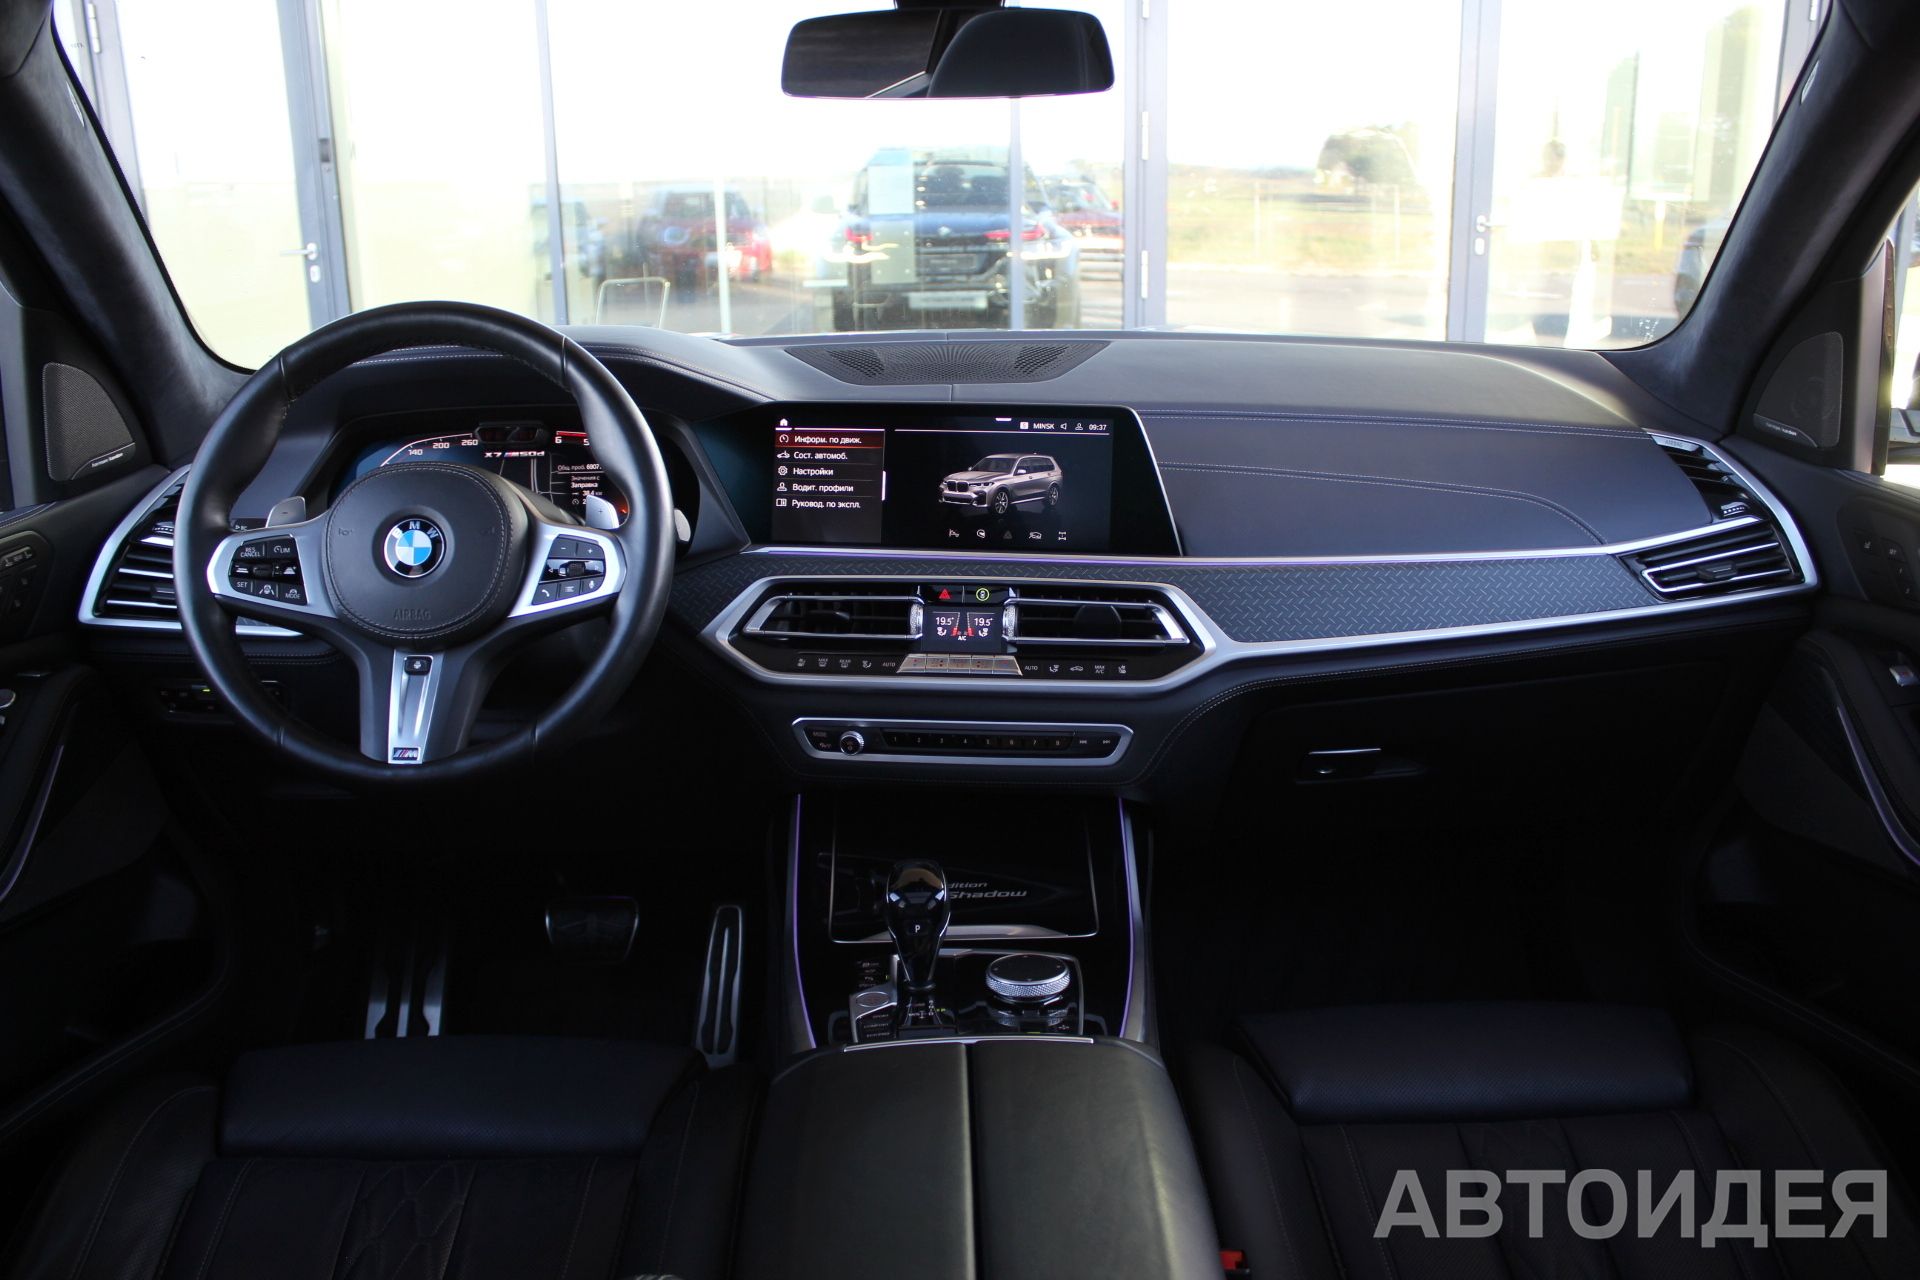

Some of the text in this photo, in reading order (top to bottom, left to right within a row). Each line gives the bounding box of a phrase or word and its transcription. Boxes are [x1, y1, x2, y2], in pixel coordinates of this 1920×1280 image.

[1033, 422, 1055, 430] MINSK
[555, 436, 562, 444] 6
[583, 438, 590, 446] 5
[794, 436, 827, 444] Информ.
[793, 451, 848, 460] Сост. автомоб.
[793, 467, 834, 476] Настройки
[792, 483, 854, 492] Водит. профили
[791, 499, 825, 508] Руковод.
[391, 520, 439, 540] BMW
[393, 608, 431, 620] AIRBAG
[950, 890, 1027, 899] Shadow
[914, 924, 921, 933] P
